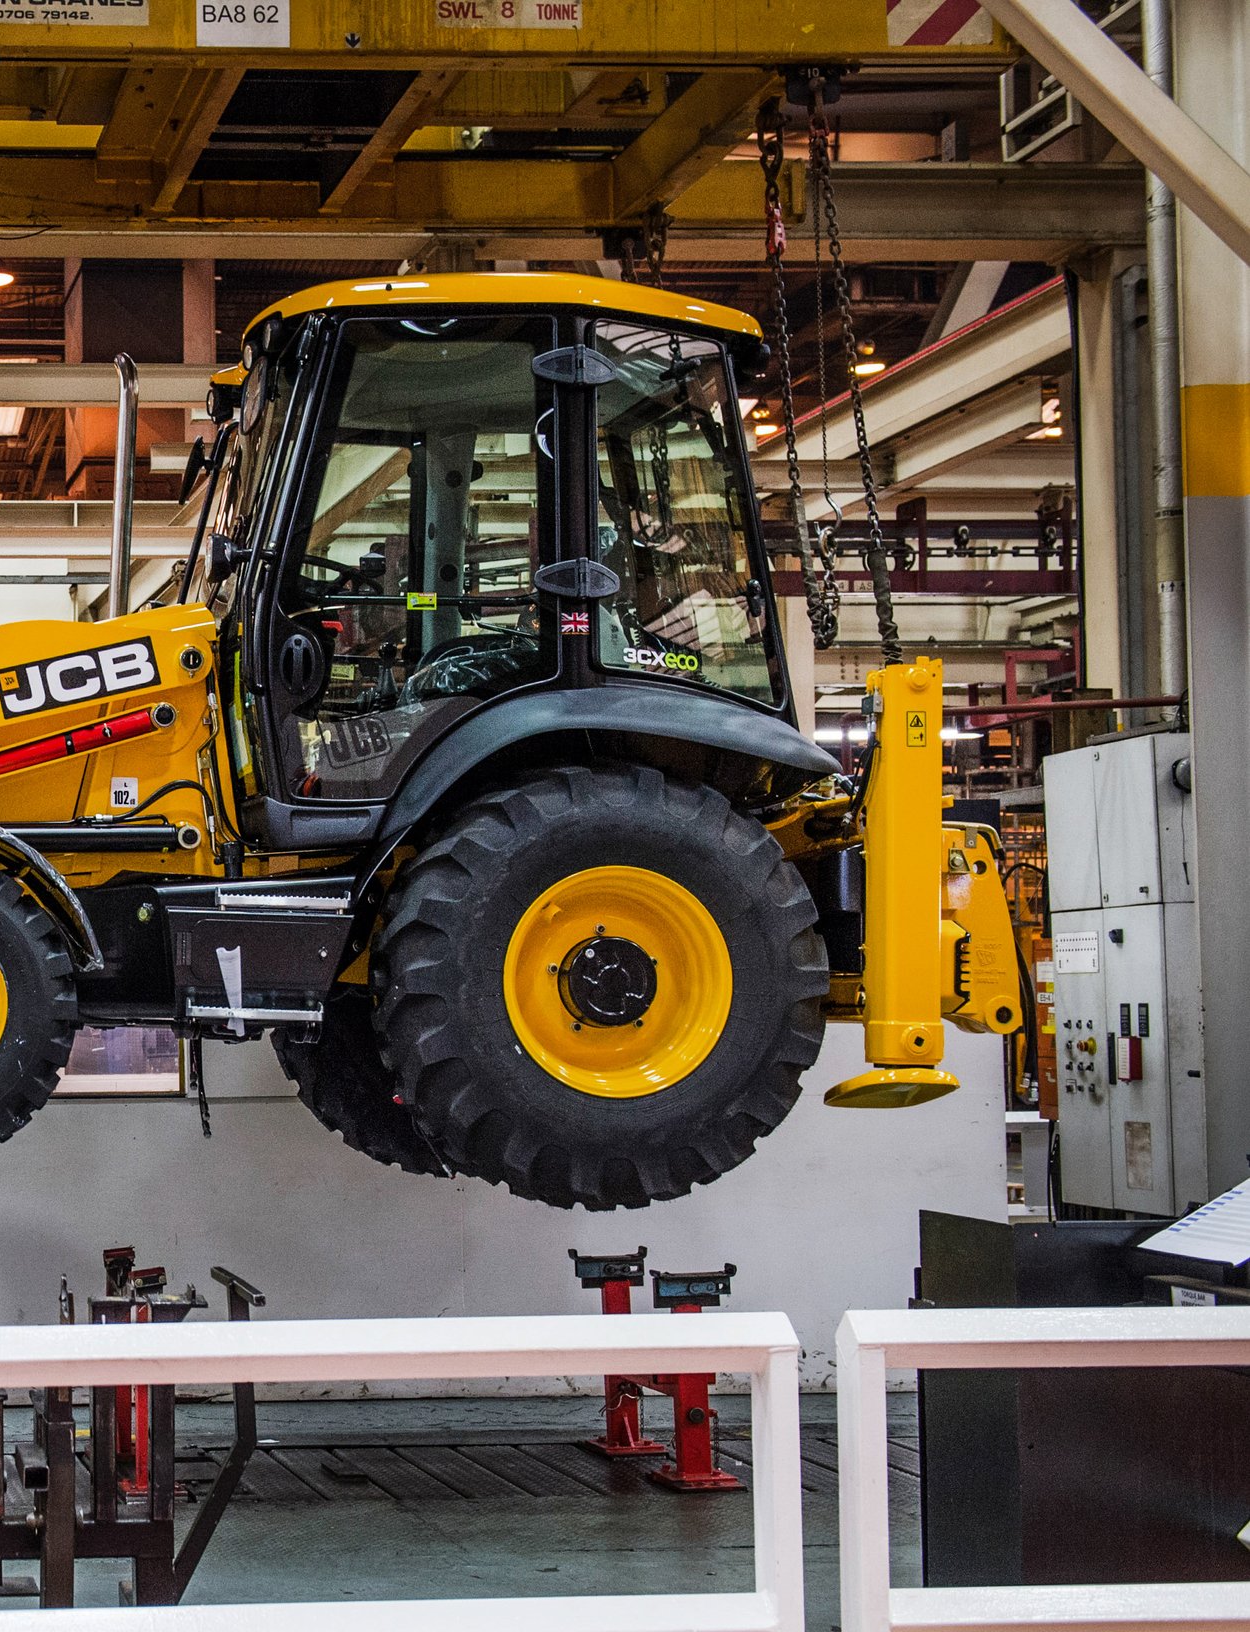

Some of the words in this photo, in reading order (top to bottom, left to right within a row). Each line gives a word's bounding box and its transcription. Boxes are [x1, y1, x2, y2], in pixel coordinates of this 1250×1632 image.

[40, 10, 94, 20] 79142.
[202, 4, 246, 23] BA8
[253, 4, 279, 23] 62
[437, 1, 484, 19] SWL
[501, 1, 515, 19] 8
[536, 3, 578, 20] TONNE
[622, 647, 698, 671] 3CXeco
[3, 643, 155, 713] JCB
[113, 790, 130, 805] 102
